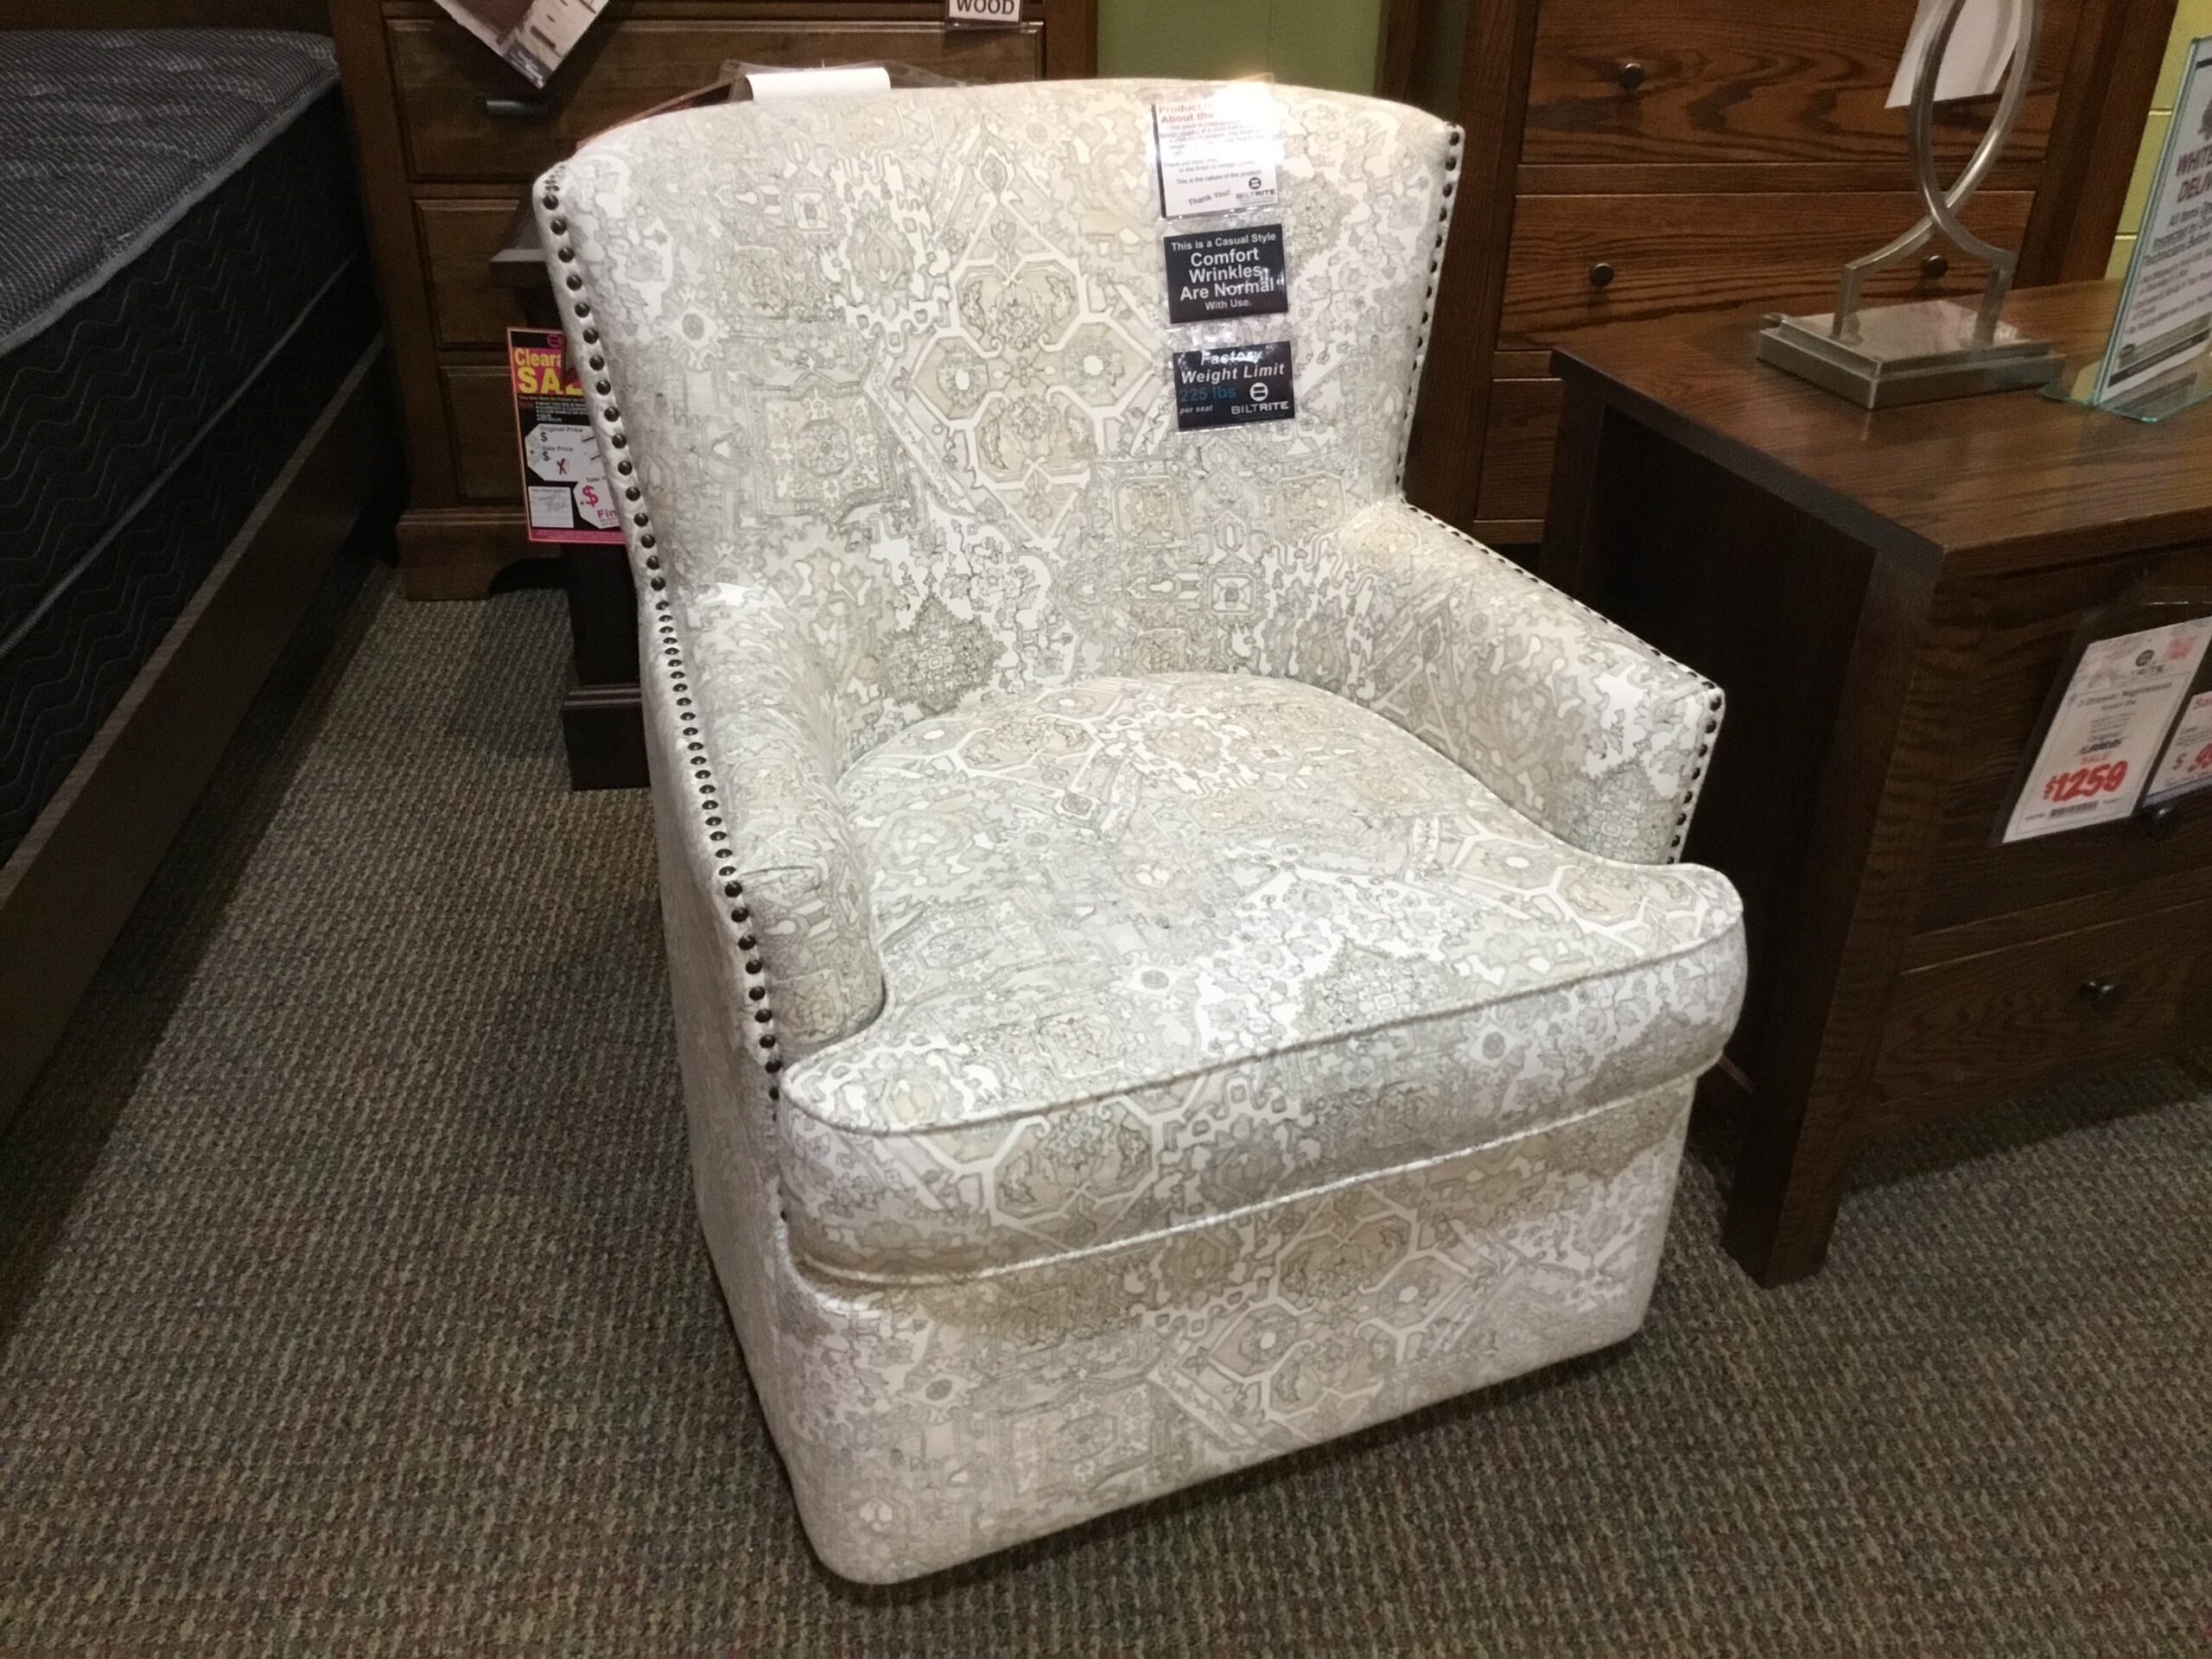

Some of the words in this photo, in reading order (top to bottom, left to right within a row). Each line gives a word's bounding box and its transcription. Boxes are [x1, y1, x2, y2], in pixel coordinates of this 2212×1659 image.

[957, 0, 1014, 15] WOOD
[1160, 113, 1193, 124] About
[1188, 194, 1212, 206] Thank
[1171, 242, 1192, 251] This
[1195, 240, 1204, 249] is
[1215, 234, 1249, 247] Casual
[1251, 232, 1276, 245] Style
[1190, 247, 1259, 267] Comfort
[1188, 264, 1262, 283] Wrinkles
[1179, 286, 1209, 302] Are
[1214, 276, 1274, 297] Normal
[1205, 300, 1227, 311] With
[1230, 298, 1252, 308] Use.
[1200, 350, 1263, 366] Factory
[1180, 367, 1238, 385] Weight
[1243, 362, 1286, 378] Limit
[1180, 386, 1208, 403] 225
[1211, 385, 1236, 399] lbs
[1179, 405, 1193, 415] per
[1195, 404, 1213, 413] seat
[1230, 400, 1289, 415] BILTRITE
